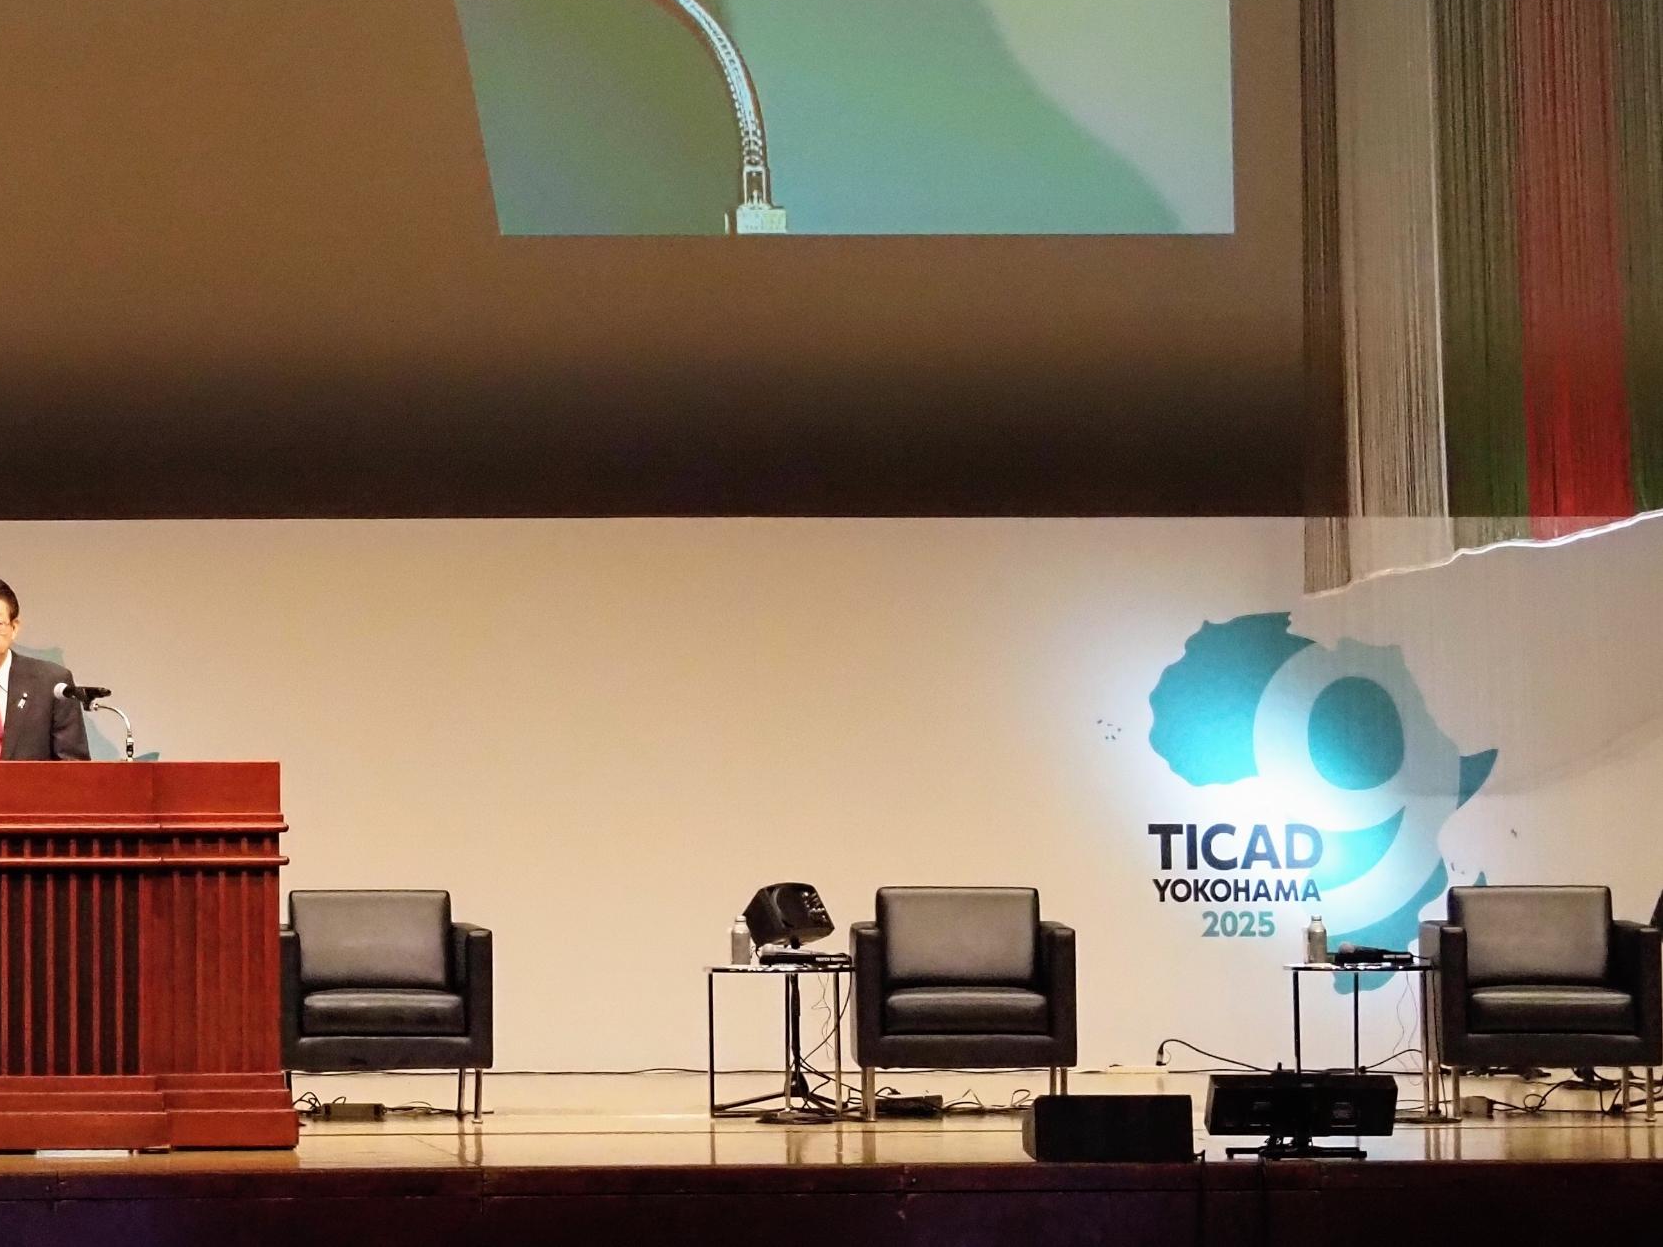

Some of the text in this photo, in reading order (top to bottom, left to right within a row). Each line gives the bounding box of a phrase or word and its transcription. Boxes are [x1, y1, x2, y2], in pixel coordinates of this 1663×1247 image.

[1148, 823, 1323, 871] TICAD
[1153, 878, 1322, 903] YOKOHAMA
[1201, 910, 1276, 938] 2025
